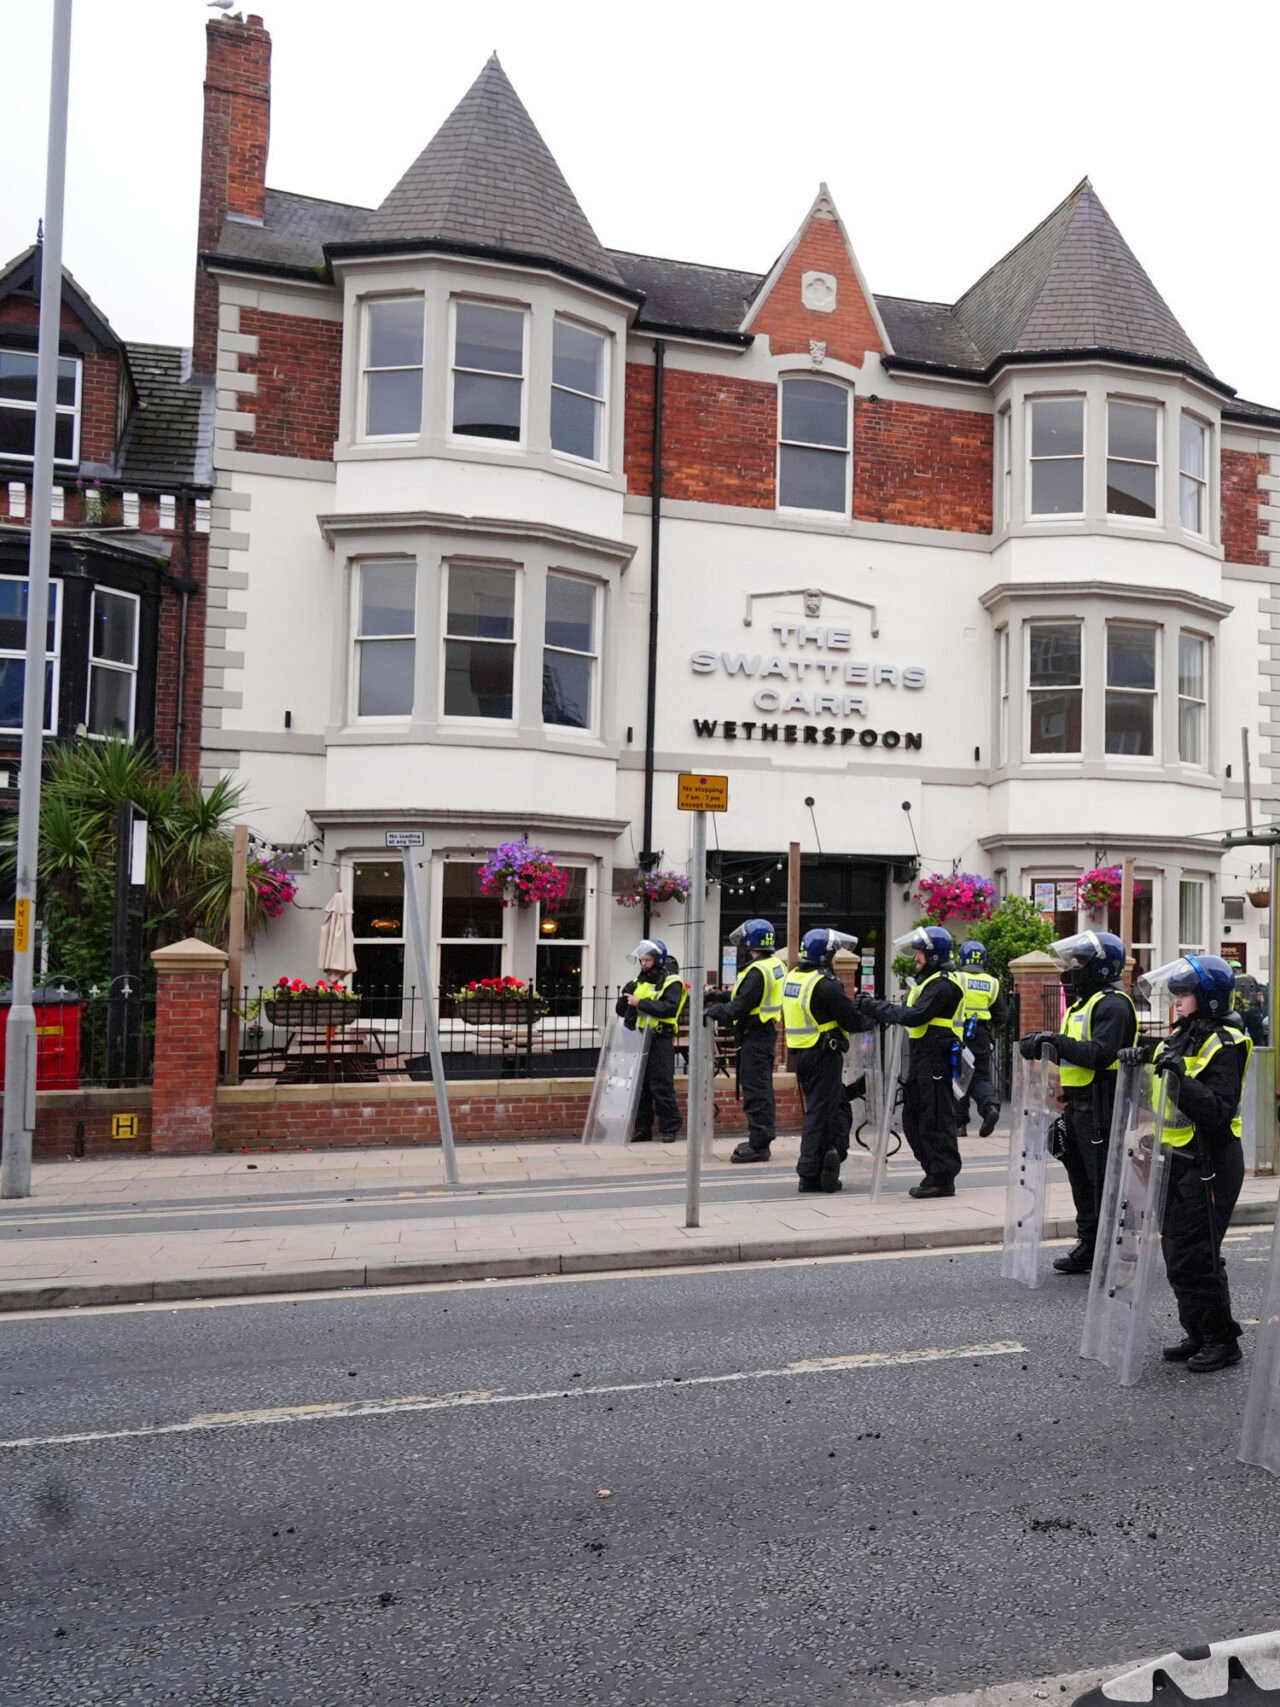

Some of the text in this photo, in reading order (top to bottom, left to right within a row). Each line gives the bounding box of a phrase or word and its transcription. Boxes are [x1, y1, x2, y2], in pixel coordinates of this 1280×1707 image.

[772, 623, 852, 649] THE
[691, 650, 927, 689] SWATTERS
[753, 688, 870, 717] CARR
[693, 718, 923, 750] WETHERSPOON
[695, 786, 724, 794] stopping
[969, 980, 990, 991] POLICE
[116, 1117, 133, 1136] H
